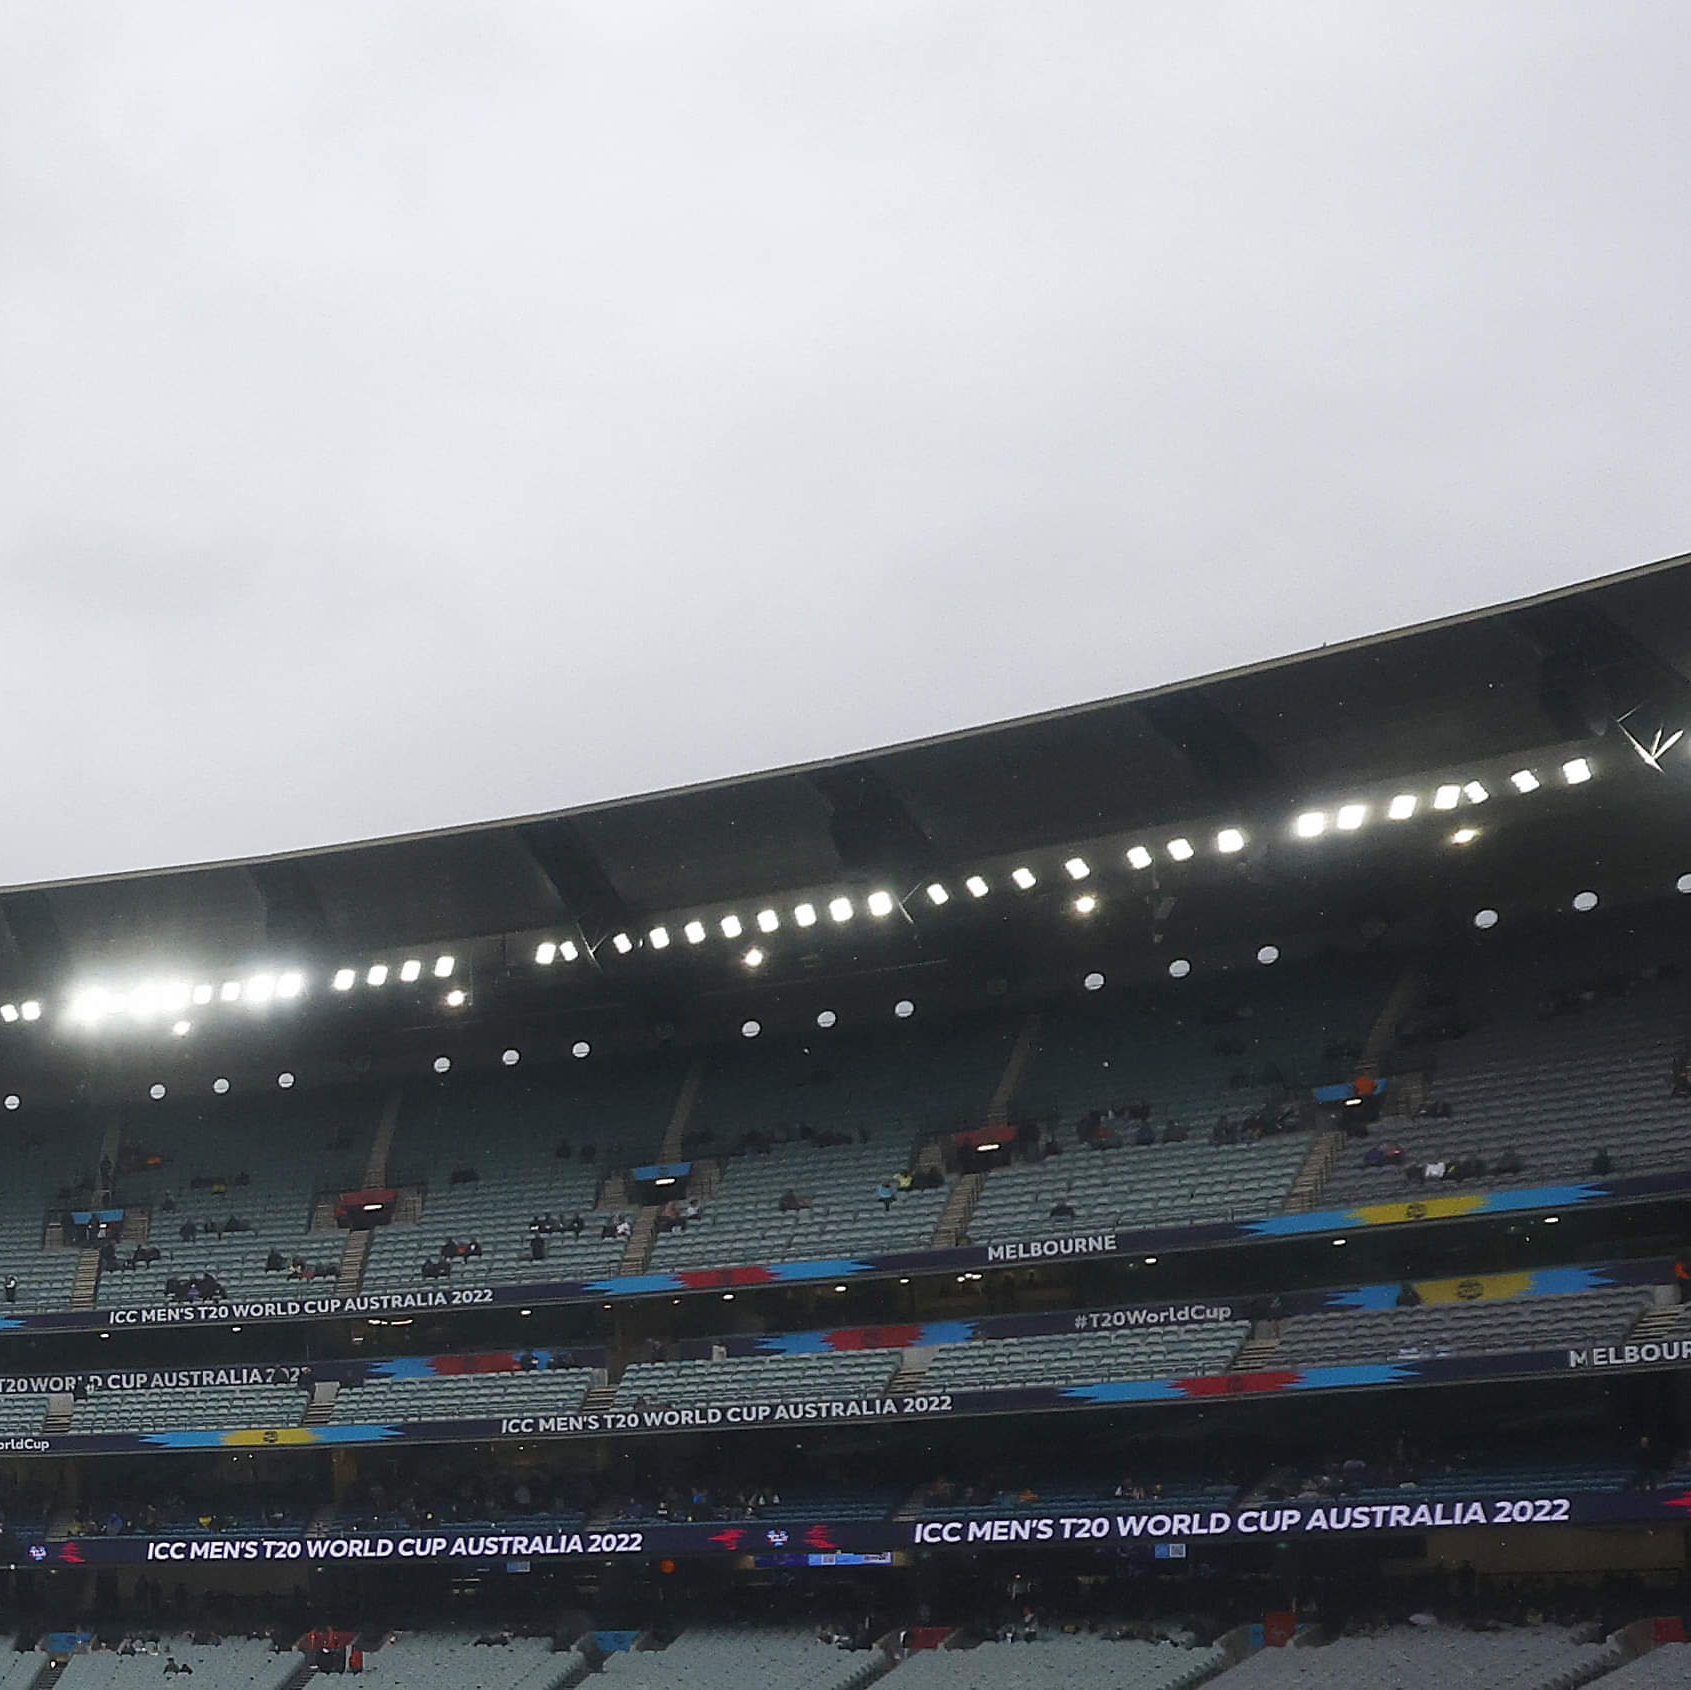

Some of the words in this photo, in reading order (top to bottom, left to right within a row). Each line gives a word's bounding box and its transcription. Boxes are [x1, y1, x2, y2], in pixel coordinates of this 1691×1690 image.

[987, 1234, 1117, 1260] MELBOURNE
[109, 1310, 137, 1323] ICC
[141, 1306, 194, 1322] MEN'S
[197, 1304, 229, 1318] T20
[231, 1300, 300, 1316] WORLD
[303, 1298, 340, 1312] CUP
[343, 1292, 447, 1310] AUSTRALIA
[451, 1290, 493, 1304] 2022
[1074, 1302, 1232, 1329] #T20WorldCup
[106, 1372, 148, 1388] CUP
[150, 1368, 262, 1387] AUSTRALIA
[265, 1367, 308, 1383] 22
[501, 1418, 534, 1434] ICC
[538, 1414, 599, 1432] MEN'S
[605, 1412, 639, 1428] T20
[645, 1407, 721, 1426] WORLD
[726, 1405, 771, 1422] CUP
[774, 1398, 898, 1419] AUSTRALIA
[903, 1395, 953, 1413] 2022
[914, 1522, 962, 1543] ICC
[967, 1518, 1053, 1541] MEN'S
[1059, 1516, 1110, 1538] T20
[1116, 1511, 1231, 1536] WORLD
[1237, 1509, 1301, 1531] CUP
[1304, 1502, 1487, 1529] AUSTRALIA
[1492, 1498, 1571, 1523] 2022
[147, 1541, 185, 1560] ICC
[189, 1540, 258, 1559] MEN'S
[261, 1539, 301, 1558] T20
[305, 1538, 393, 1557] WORLD
[397, 1537, 447, 1555] CUP
[449, 1534, 583, 1554] AUSTRALIA
[587, 1533, 643, 1552] 2022
